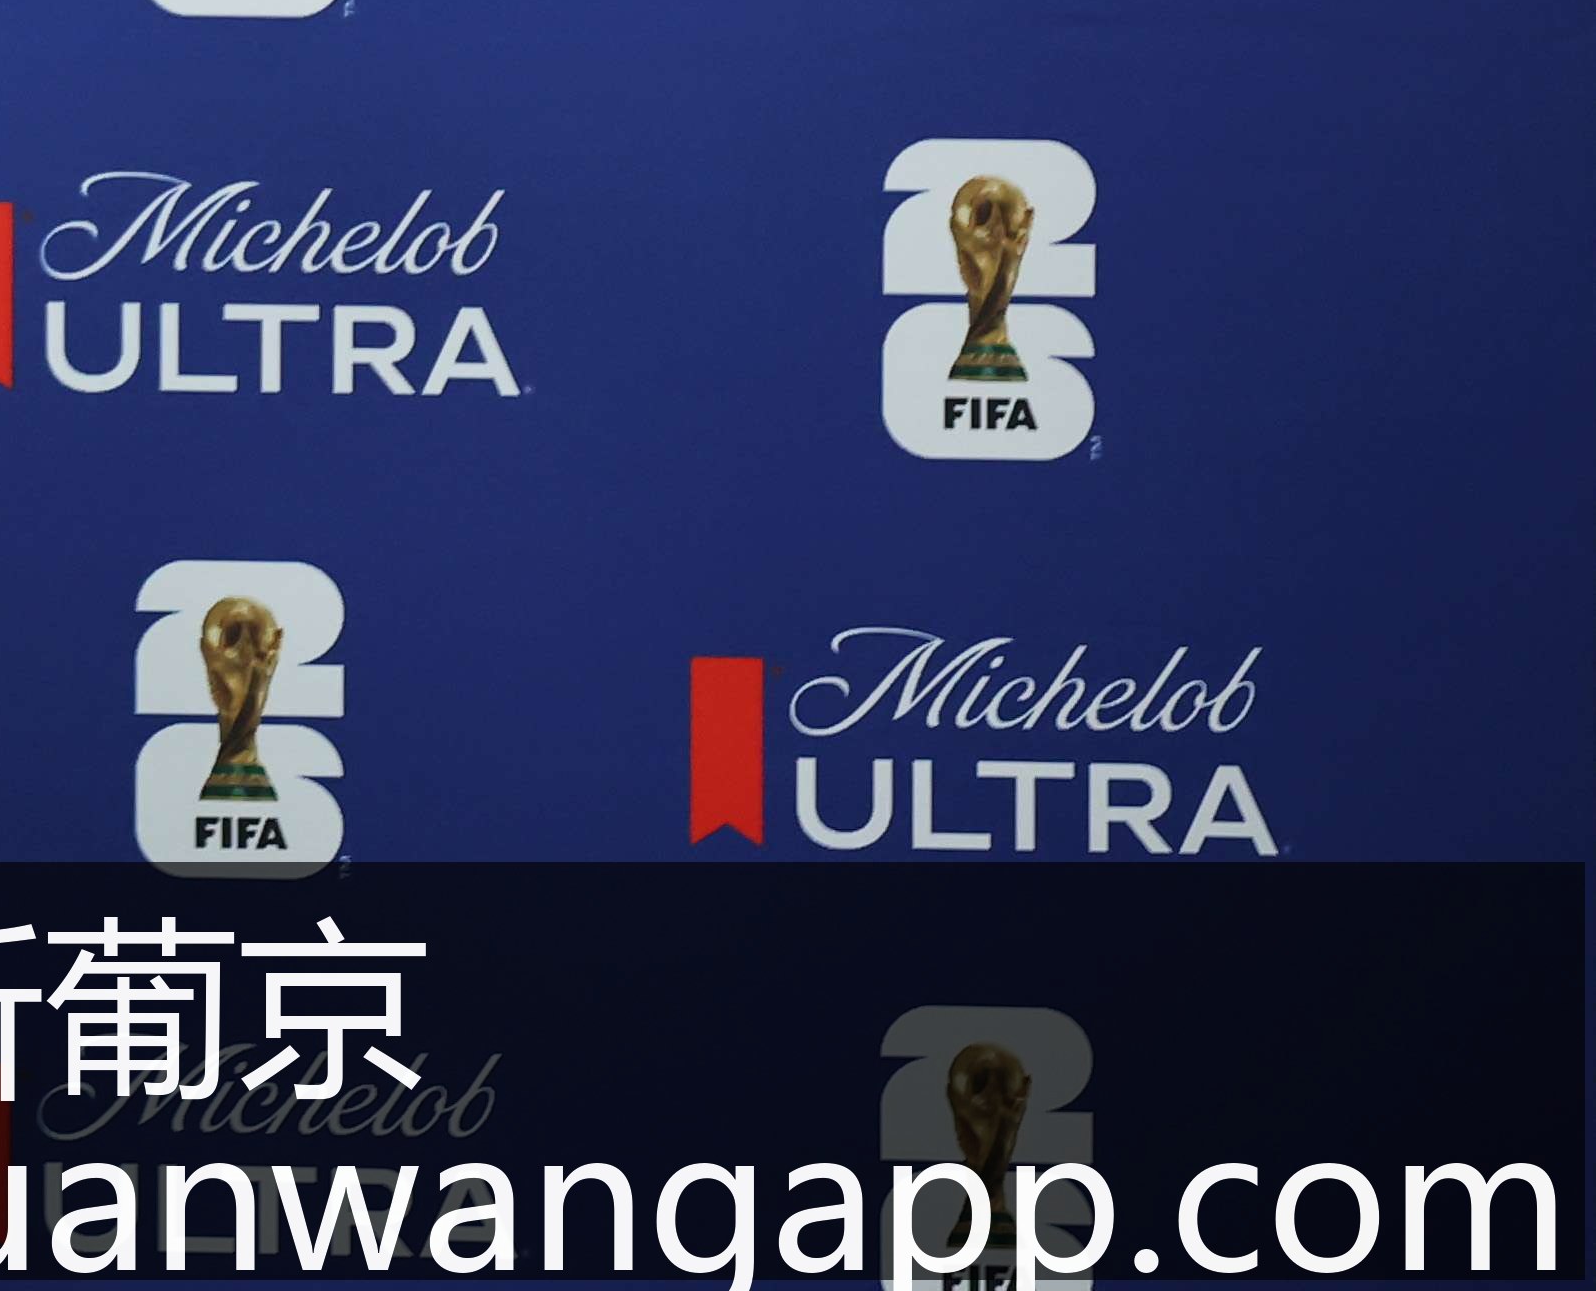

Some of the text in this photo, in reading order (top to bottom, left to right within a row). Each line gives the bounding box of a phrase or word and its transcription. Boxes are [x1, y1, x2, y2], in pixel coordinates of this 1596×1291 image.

[41, 172, 505, 280] Michelob
[46, 301, 520, 396] ULTRA
[944, 397, 1038, 431] FIFA
[790, 627, 1262, 736] Michelob
[195, 816, 288, 850] FIFA
[796, 757, 1278, 856] ULTRA
